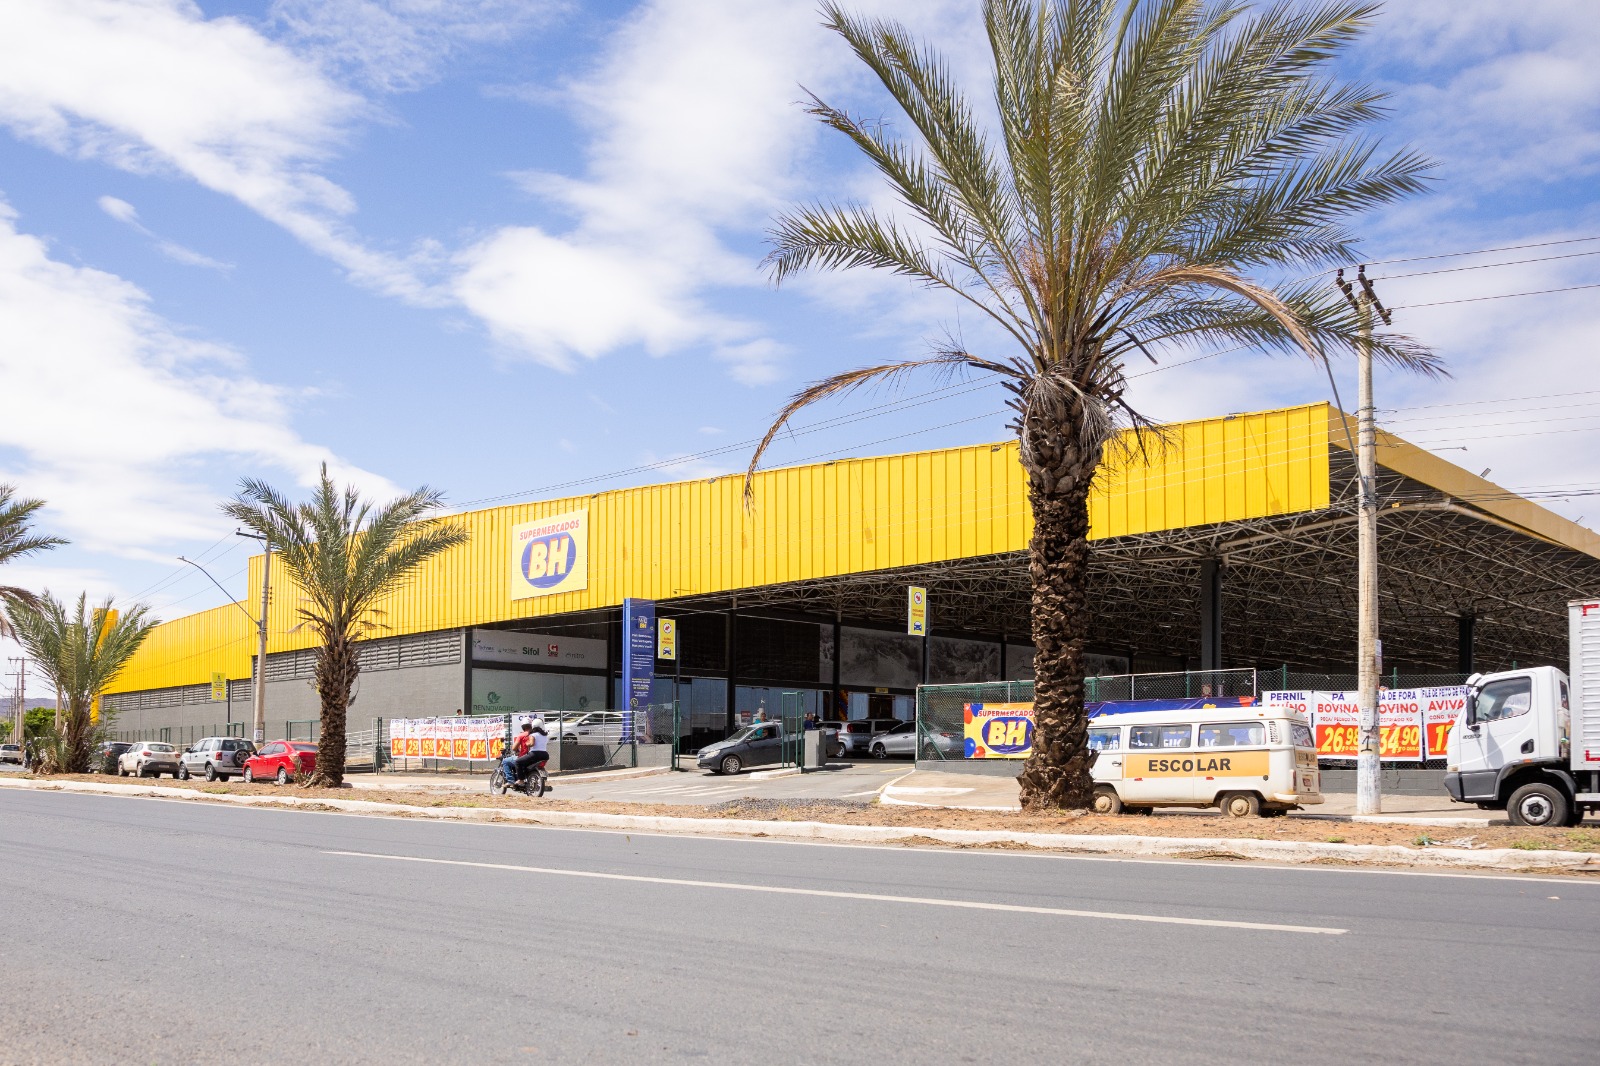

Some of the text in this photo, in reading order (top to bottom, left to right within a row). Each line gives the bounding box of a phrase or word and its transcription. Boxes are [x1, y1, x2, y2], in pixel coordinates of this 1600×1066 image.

[519, 519, 580, 541] SUPERMERCADOS
[527, 535, 570, 580] BH
[522, 646, 540, 656] Sifol
[1270, 692, 1306, 701] PERNIL
[1331, 691, 1345, 701] PÁ
[1388, 692, 1397, 701] DE
[1398, 691, 1417, 700] FORA
[1317, 703, 1359, 714] BOVINA
[1379, 703, 1419, 714] OVINO
[1428, 699, 1464, 711] AVIVA
[987, 719, 1028, 746] BH
[1148, 757, 1233, 772] ESCOLAR
